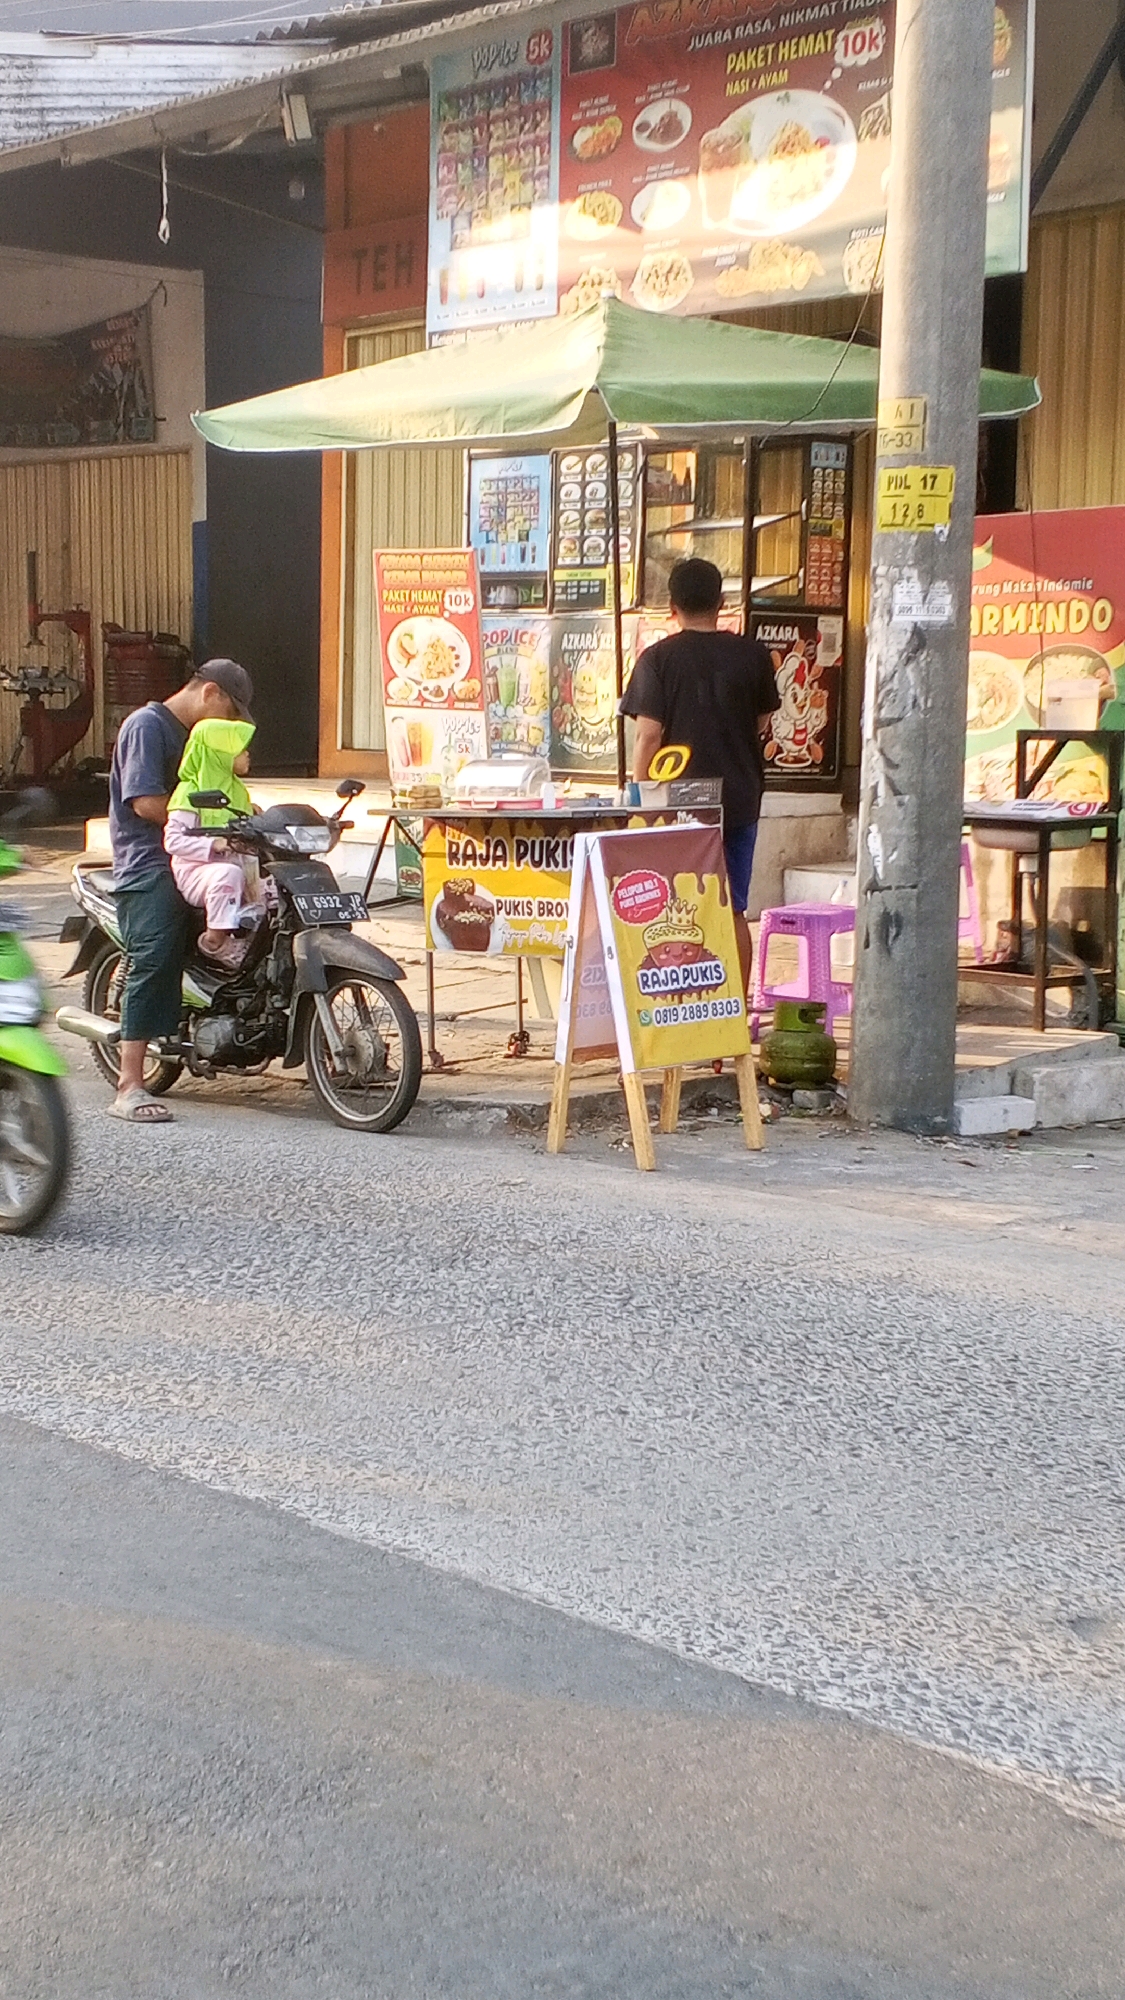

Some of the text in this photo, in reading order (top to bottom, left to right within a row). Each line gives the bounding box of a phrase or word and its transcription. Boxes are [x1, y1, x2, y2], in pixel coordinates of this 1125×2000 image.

[688, 29, 732, 51] JUARA
[779, 3, 838, 28] NIKMAT
[726, 44, 777, 75] PAKET
[778, 29, 836, 64] HEMAT
[725, 79, 750, 97] NASI
[758, 69, 789, 91] AYAM
[920, 473, 939, 491] 17
[382, 589, 410, 603] PAKET
[411, 589, 443, 603] HEMAT
[972, 583, 1000, 597] rung
[1043, 577, 1093, 592] Indomie
[970, 598, 1113, 636] ARMINDO
[755, 624, 800, 641] AZKARA
[447, 838, 508, 868] RAJA
[495, 899, 533, 917] PUKIS
[640, 963, 723, 990] RAJA PUKIS
[654, 999, 740, 1025] 0819 2889 8303
